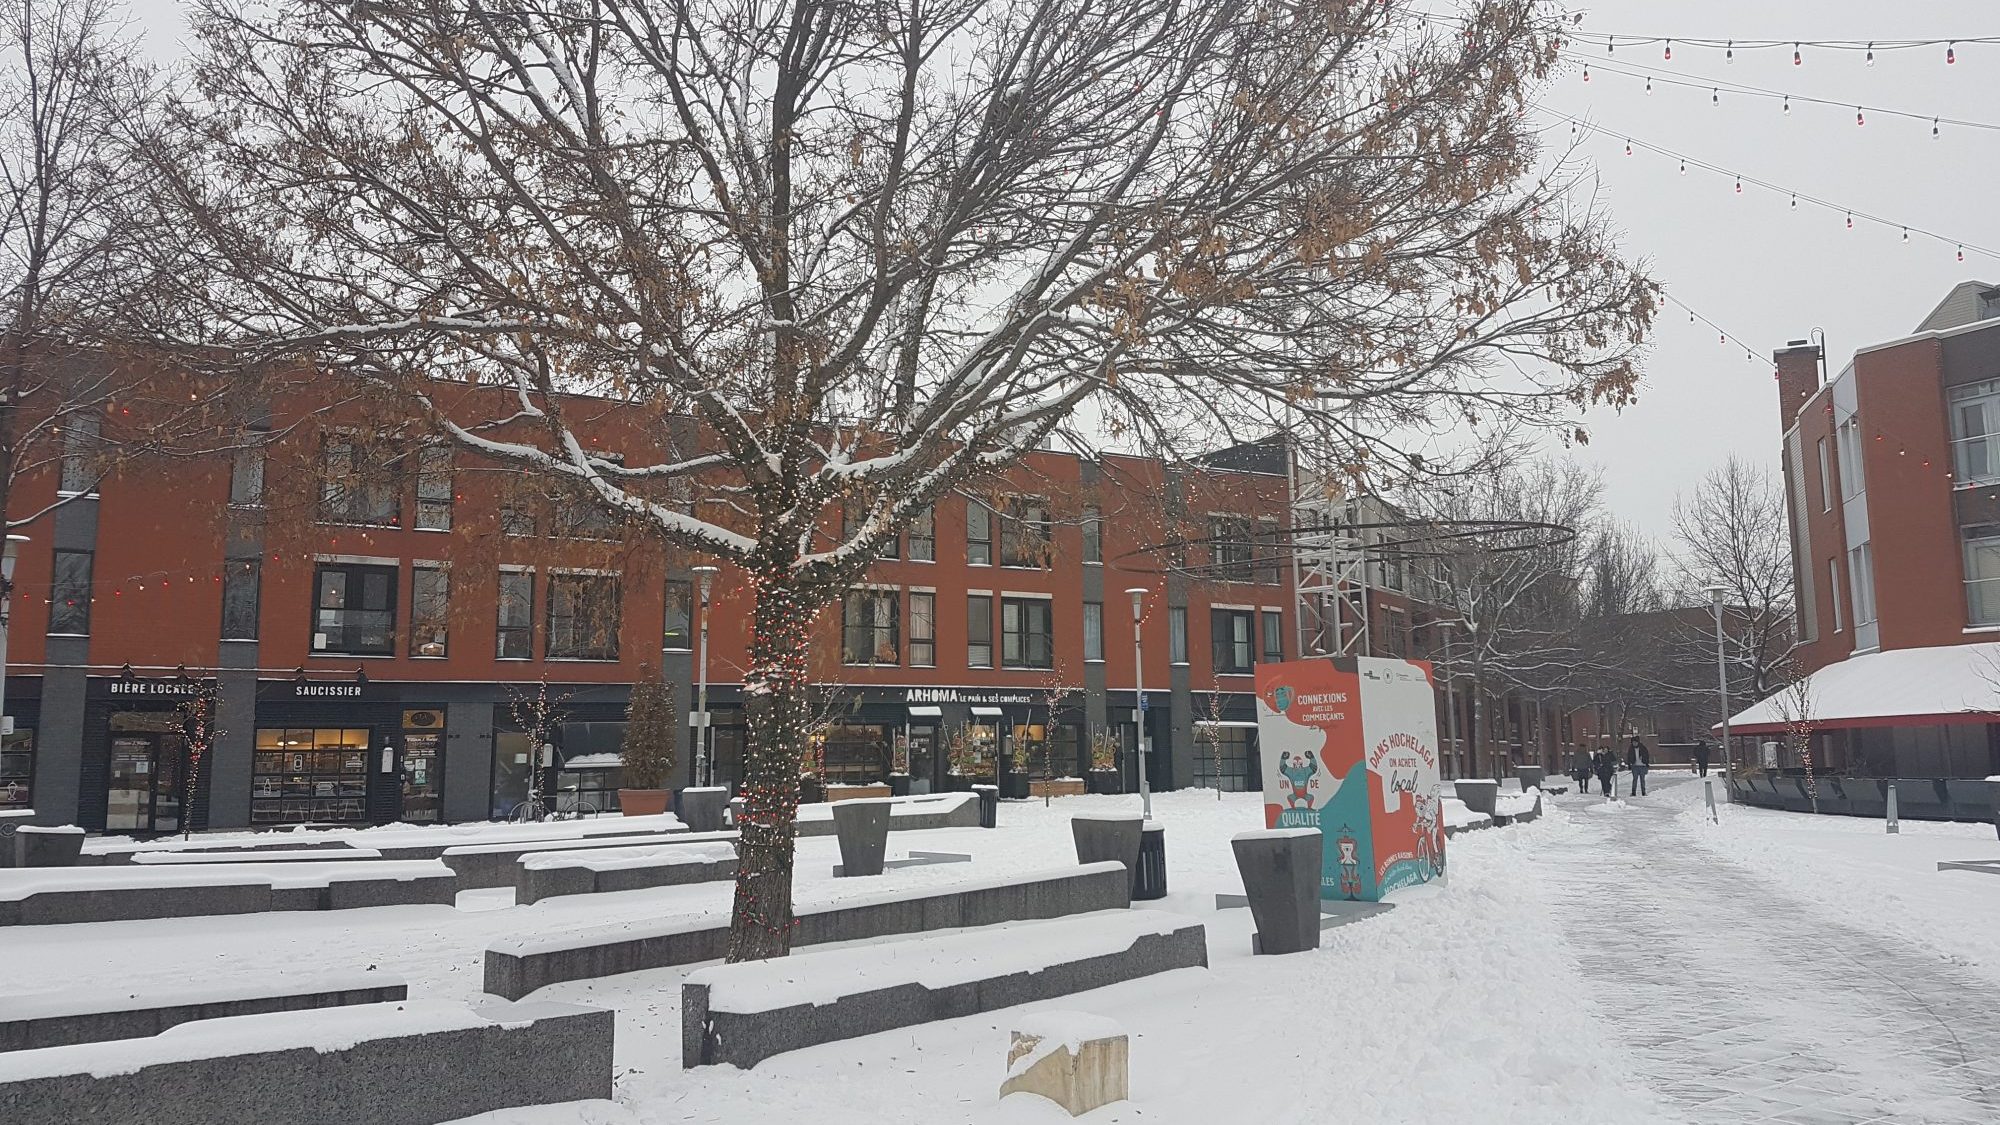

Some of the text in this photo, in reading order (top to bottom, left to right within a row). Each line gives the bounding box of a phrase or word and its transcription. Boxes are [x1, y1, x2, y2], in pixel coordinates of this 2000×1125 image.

[111, 682, 194, 695] BIÈRE LOCALE
[295, 686, 361, 696] SAUCISSIER
[906, 689, 957, 703] ARHOMA
[988, 695, 998, 703] SES
[1297, 693, 1348, 705] CONNEXIONS
[1302, 713, 1345, 722] COMMERÇANTS
[1369, 732, 1435, 770] DANS HOCHELAGA
[1389, 758, 1397, 768] ON
[1279, 780, 1290, 789] UN
[1310, 780, 1319, 789] DE
[1390, 769, 1419, 793] local
[1281, 809, 1321, 827] QUALITÉ
[1384, 871, 1418, 895] HOCHELAGA
